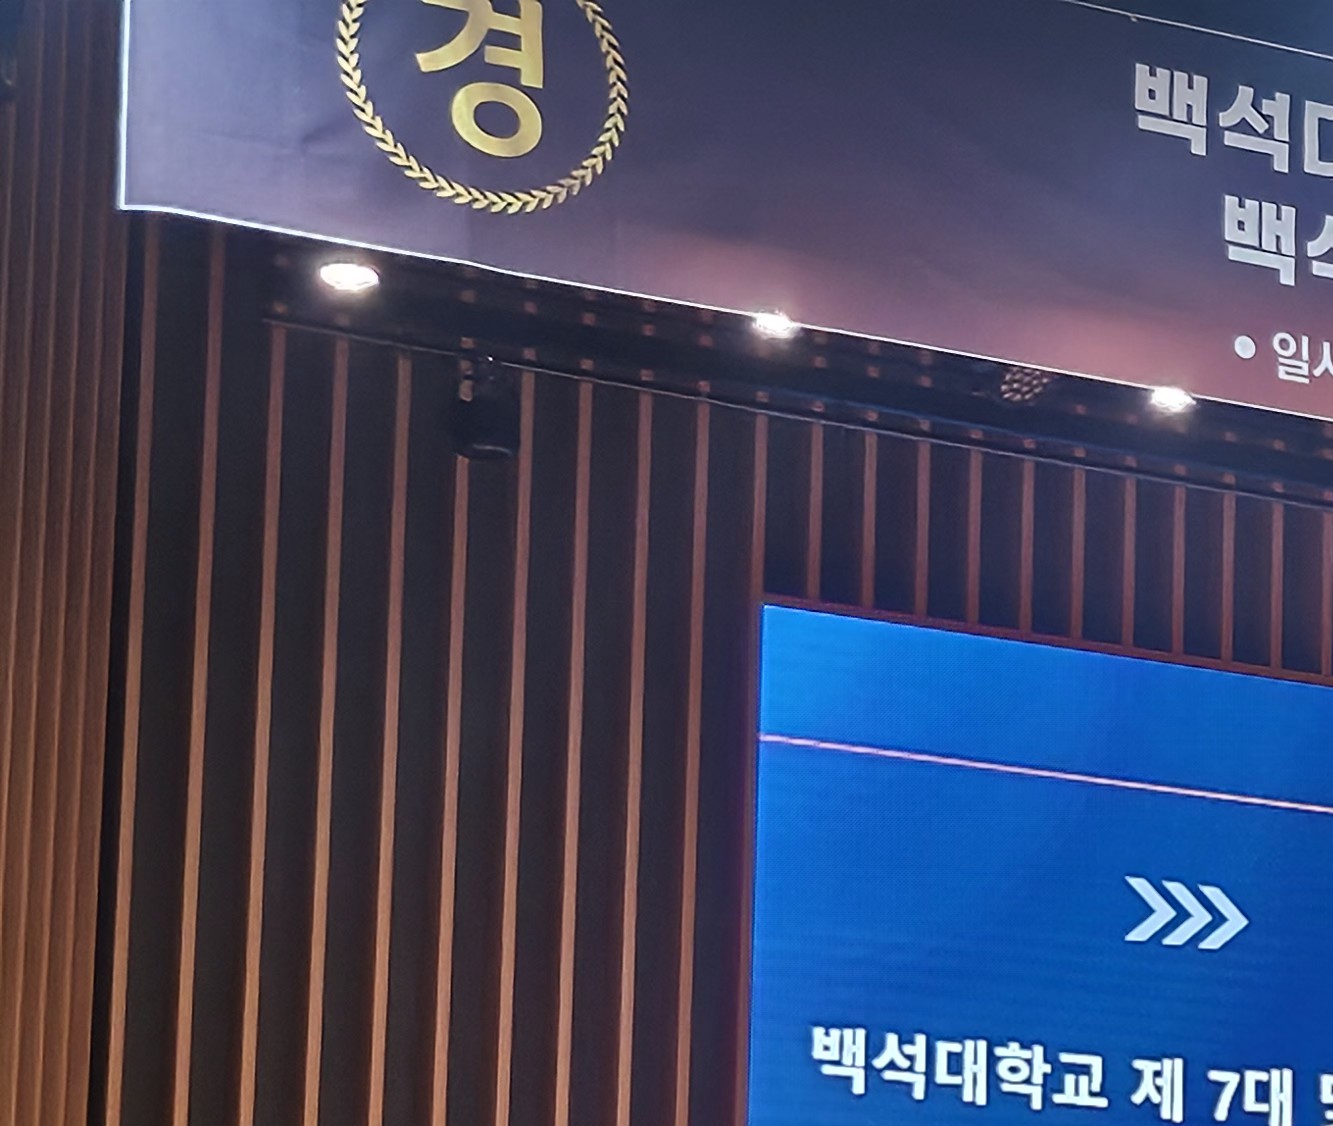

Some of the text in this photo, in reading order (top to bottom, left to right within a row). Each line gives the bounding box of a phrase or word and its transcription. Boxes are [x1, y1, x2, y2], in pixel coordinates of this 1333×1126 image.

[415, 0, 544, 158] 경
[812, 1027, 1108, 1109] 백석대학교
[1131, 1058, 1183, 1122] 제
